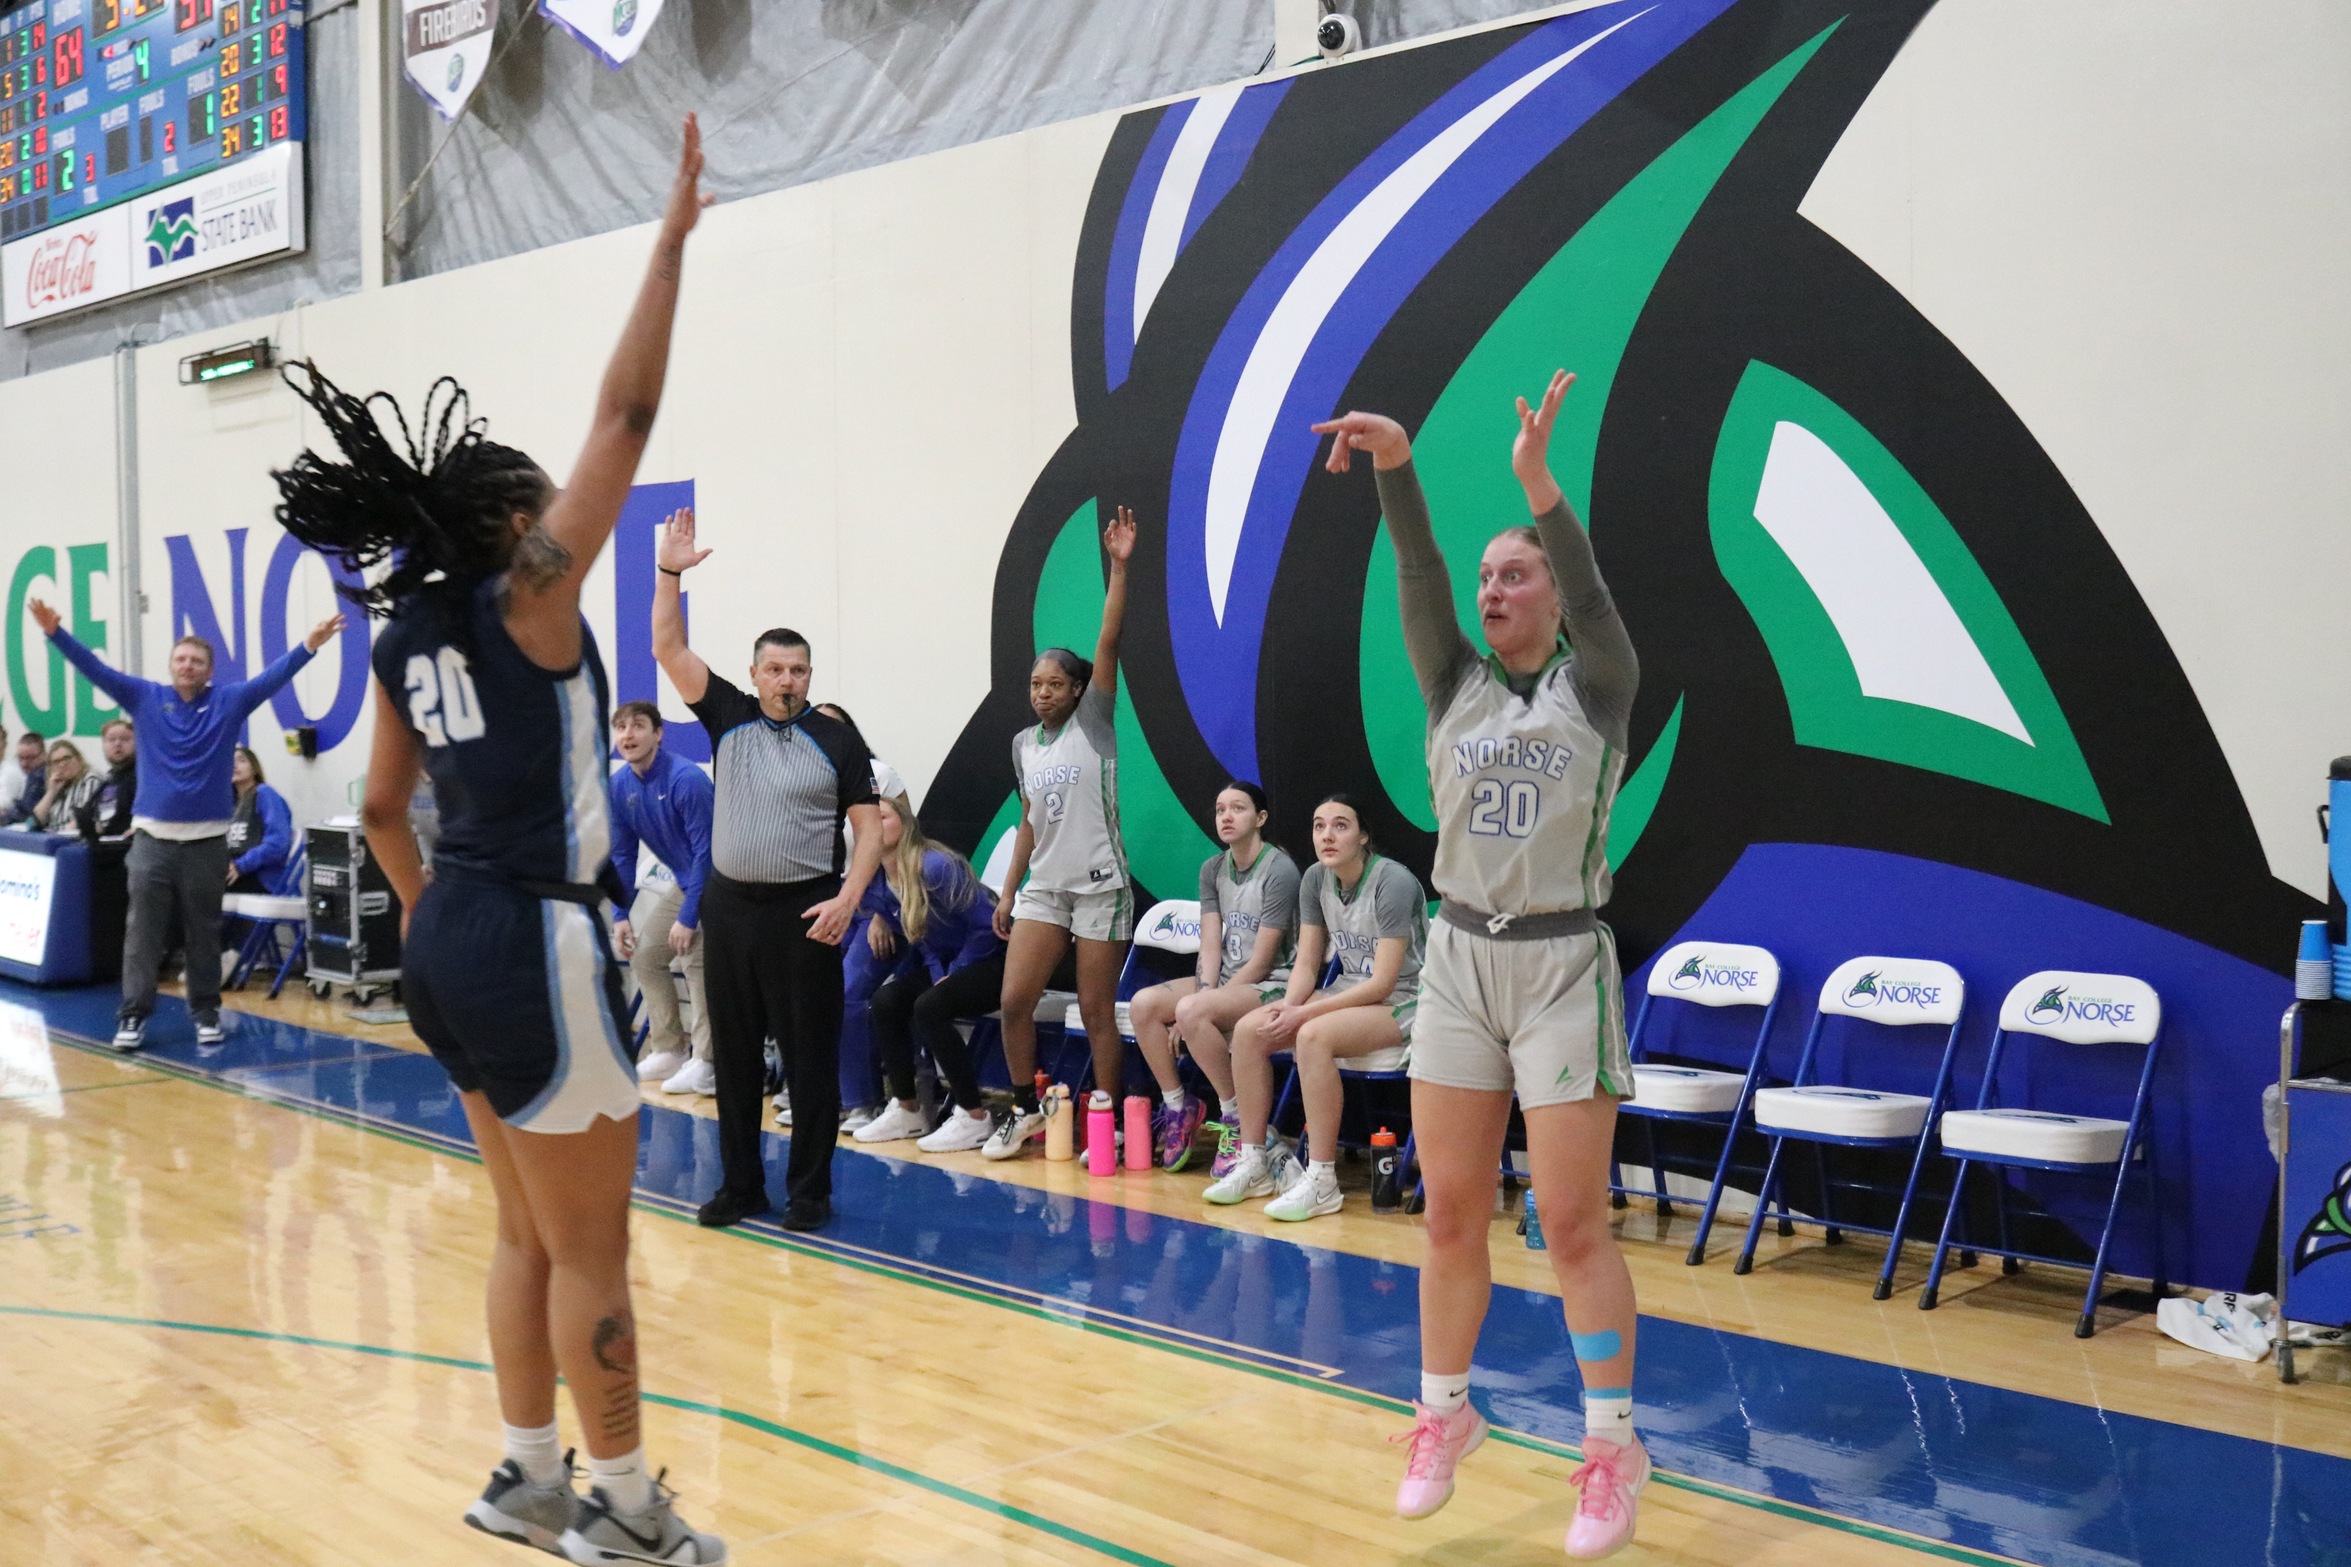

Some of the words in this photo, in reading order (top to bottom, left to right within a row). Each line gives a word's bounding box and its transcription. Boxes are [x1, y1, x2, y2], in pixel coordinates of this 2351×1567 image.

[419, 0, 486, 47] FIREBIRDS
[20, 30, 29, 56] 3
[55, 26, 83, 87] 64
[135, 38, 149, 79] 4
[252, 33, 262, 64] 3
[4, 72, 13, 99] 5
[20, 64, 29, 91] 3
[37, 56, 47, 83] 6
[275, 64, 287, 94] 9
[37, 90, 47, 119] 2
[206, 92, 214, 135] 1
[221, 83, 240, 118] 22
[164, 121, 175, 153] 2
[222, 125, 241, 158] 34
[252, 114, 263, 146] 3
[21, 133, 31, 160] 2
[61, 148, 75, 190] 2
[84, 153, 95, 183] 3
[202, 211, 236, 252] STATE
[239, 199, 278, 240] BANK
[0, 541, 122, 740] GE
[403, 644, 487, 748] 20
[1452, 735, 1573, 781] NORSE
[1023, 764, 1082, 796] NORSE
[1044, 791, 1065, 825] 2
[1469, 778, 1540, 838] 20
[0, 874, 40, 902] omino's
[1172, 920, 1200, 940] NOR
[1699, 968, 1759, 992] NORSE
[1875, 985, 1942, 1010] NORSE
[2061, 1001, 2136, 1028] NORSE
[1377, 1156, 1394, 1175] G
